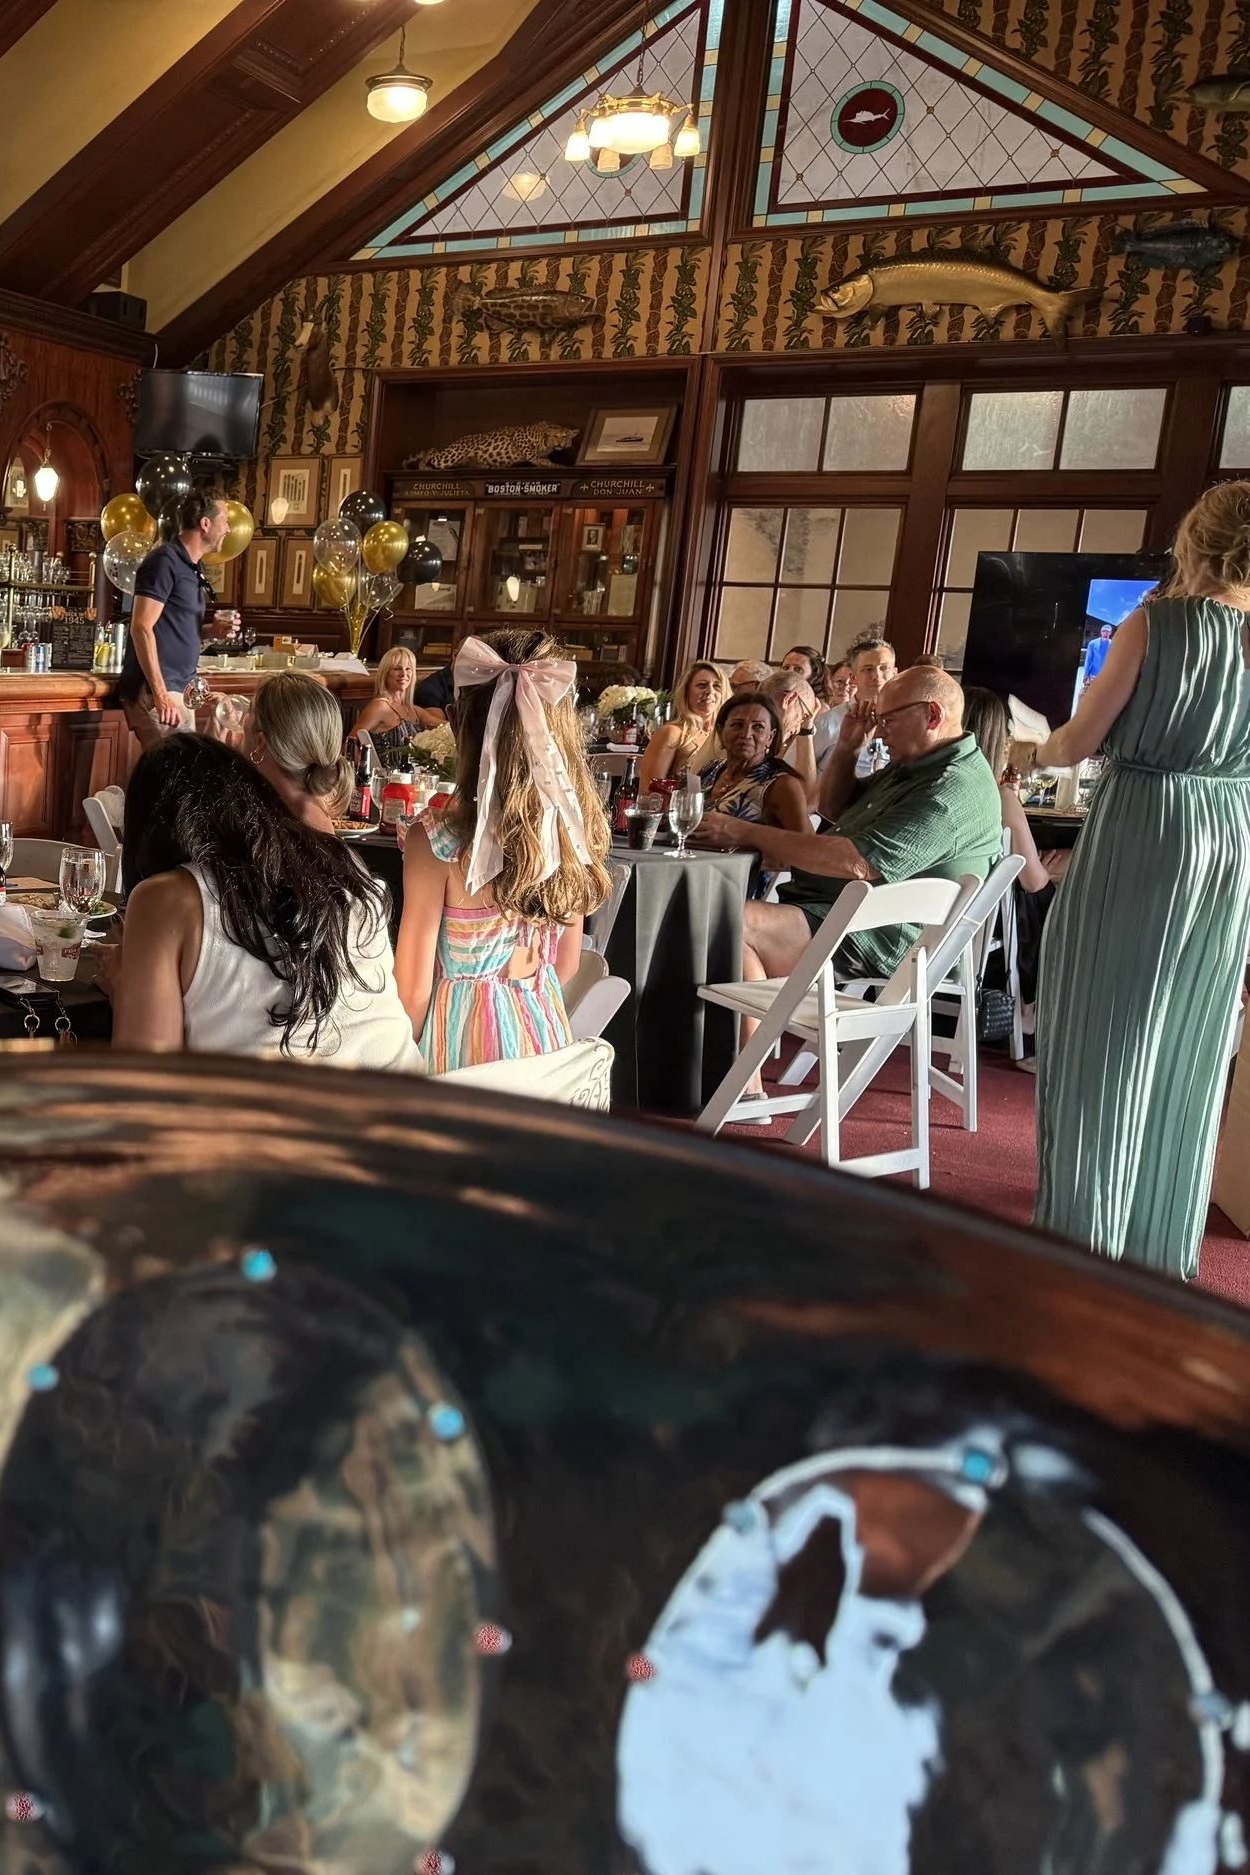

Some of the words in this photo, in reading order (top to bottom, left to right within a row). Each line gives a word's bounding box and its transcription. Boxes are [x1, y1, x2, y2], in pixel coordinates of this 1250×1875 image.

[413, 482, 462, 490] CHURCHILL
[590, 480, 645, 488] CHURCHILL
[593, 488, 613, 496] DON
[615, 488, 643, 496] JUAN
[64, 616, 85, 625] 1945
